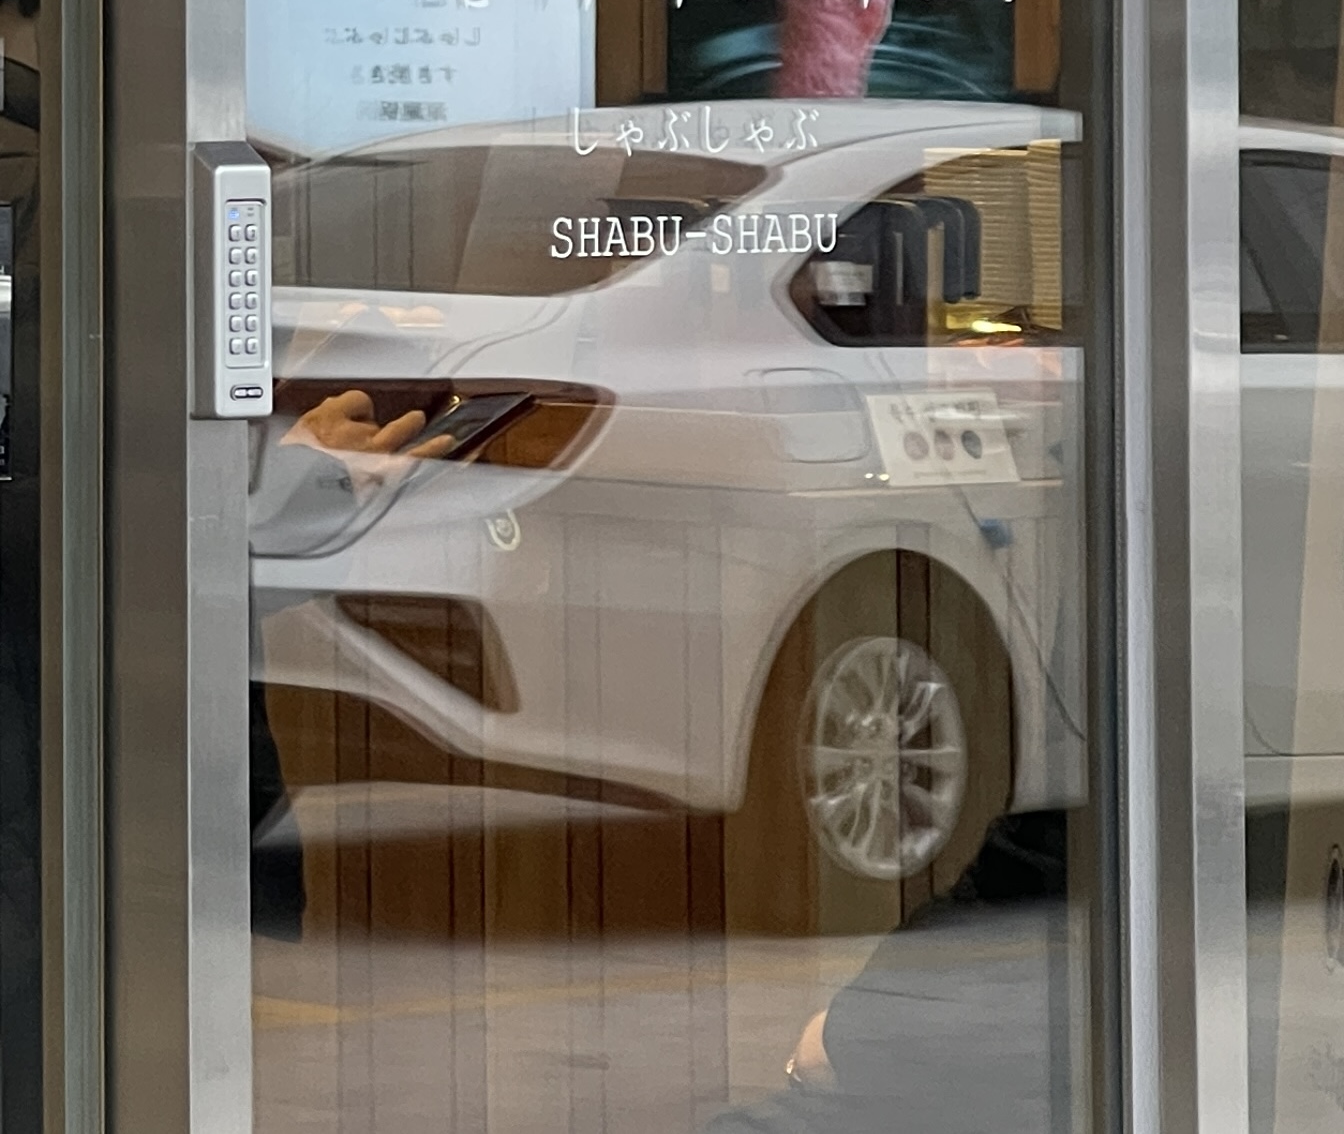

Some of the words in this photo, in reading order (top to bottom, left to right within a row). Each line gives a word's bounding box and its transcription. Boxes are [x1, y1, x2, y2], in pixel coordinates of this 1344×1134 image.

[573, 106, 822, 156] しゃぶしゃぶ
[551, 212, 839, 259] SHABU-SHABU
